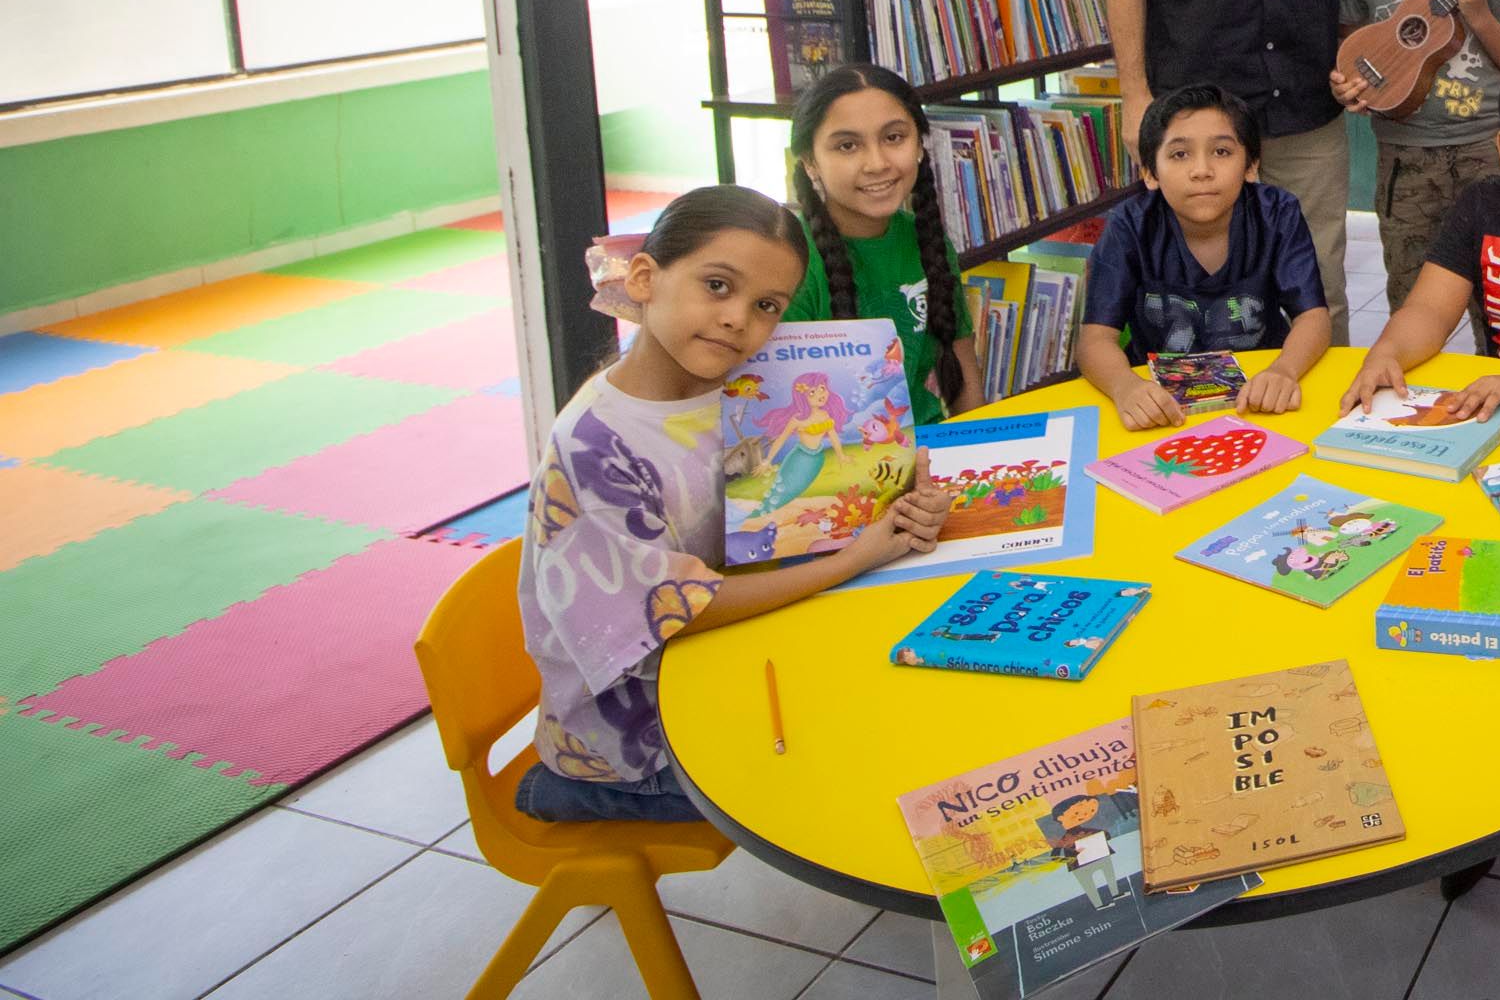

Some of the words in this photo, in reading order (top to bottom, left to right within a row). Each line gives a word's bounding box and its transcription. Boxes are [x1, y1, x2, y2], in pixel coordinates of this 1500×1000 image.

[775, 341, 871, 361] sirenita
[936, 421, 1042, 438] changuitos
[1279, 499, 1328, 525] molinos
[1428, 539, 1447, 573] patito
[1407, 567, 1424, 577] El
[949, 591, 1002, 626] Sólo
[989, 591, 1047, 634] para
[1028, 590, 1091, 642] chicos
[1430, 632, 1480, 648] patito
[1484, 636, 1498, 649] El
[946, 657, 970, 672] Sólo
[973, 661, 1000, 675] para
[1003, 664, 1039, 677] chicos
[1226, 706, 1276, 730] IM
[1233, 728, 1279, 751] PO
[938, 769, 1020, 822] NICO
[1033, 739, 1129, 779] dibuja
[1235, 769, 1284, 792] BLE
[957, 812, 982, 828] un
[986, 757, 1136, 817] sentimiento
[1252, 834, 1301, 851] ISOL
[1027, 918, 1051, 933] Bob
[1028, 917, 1074, 942] Raczka
[1033, 934, 1082, 963] Simone
[1084, 920, 1112, 938] Shin
